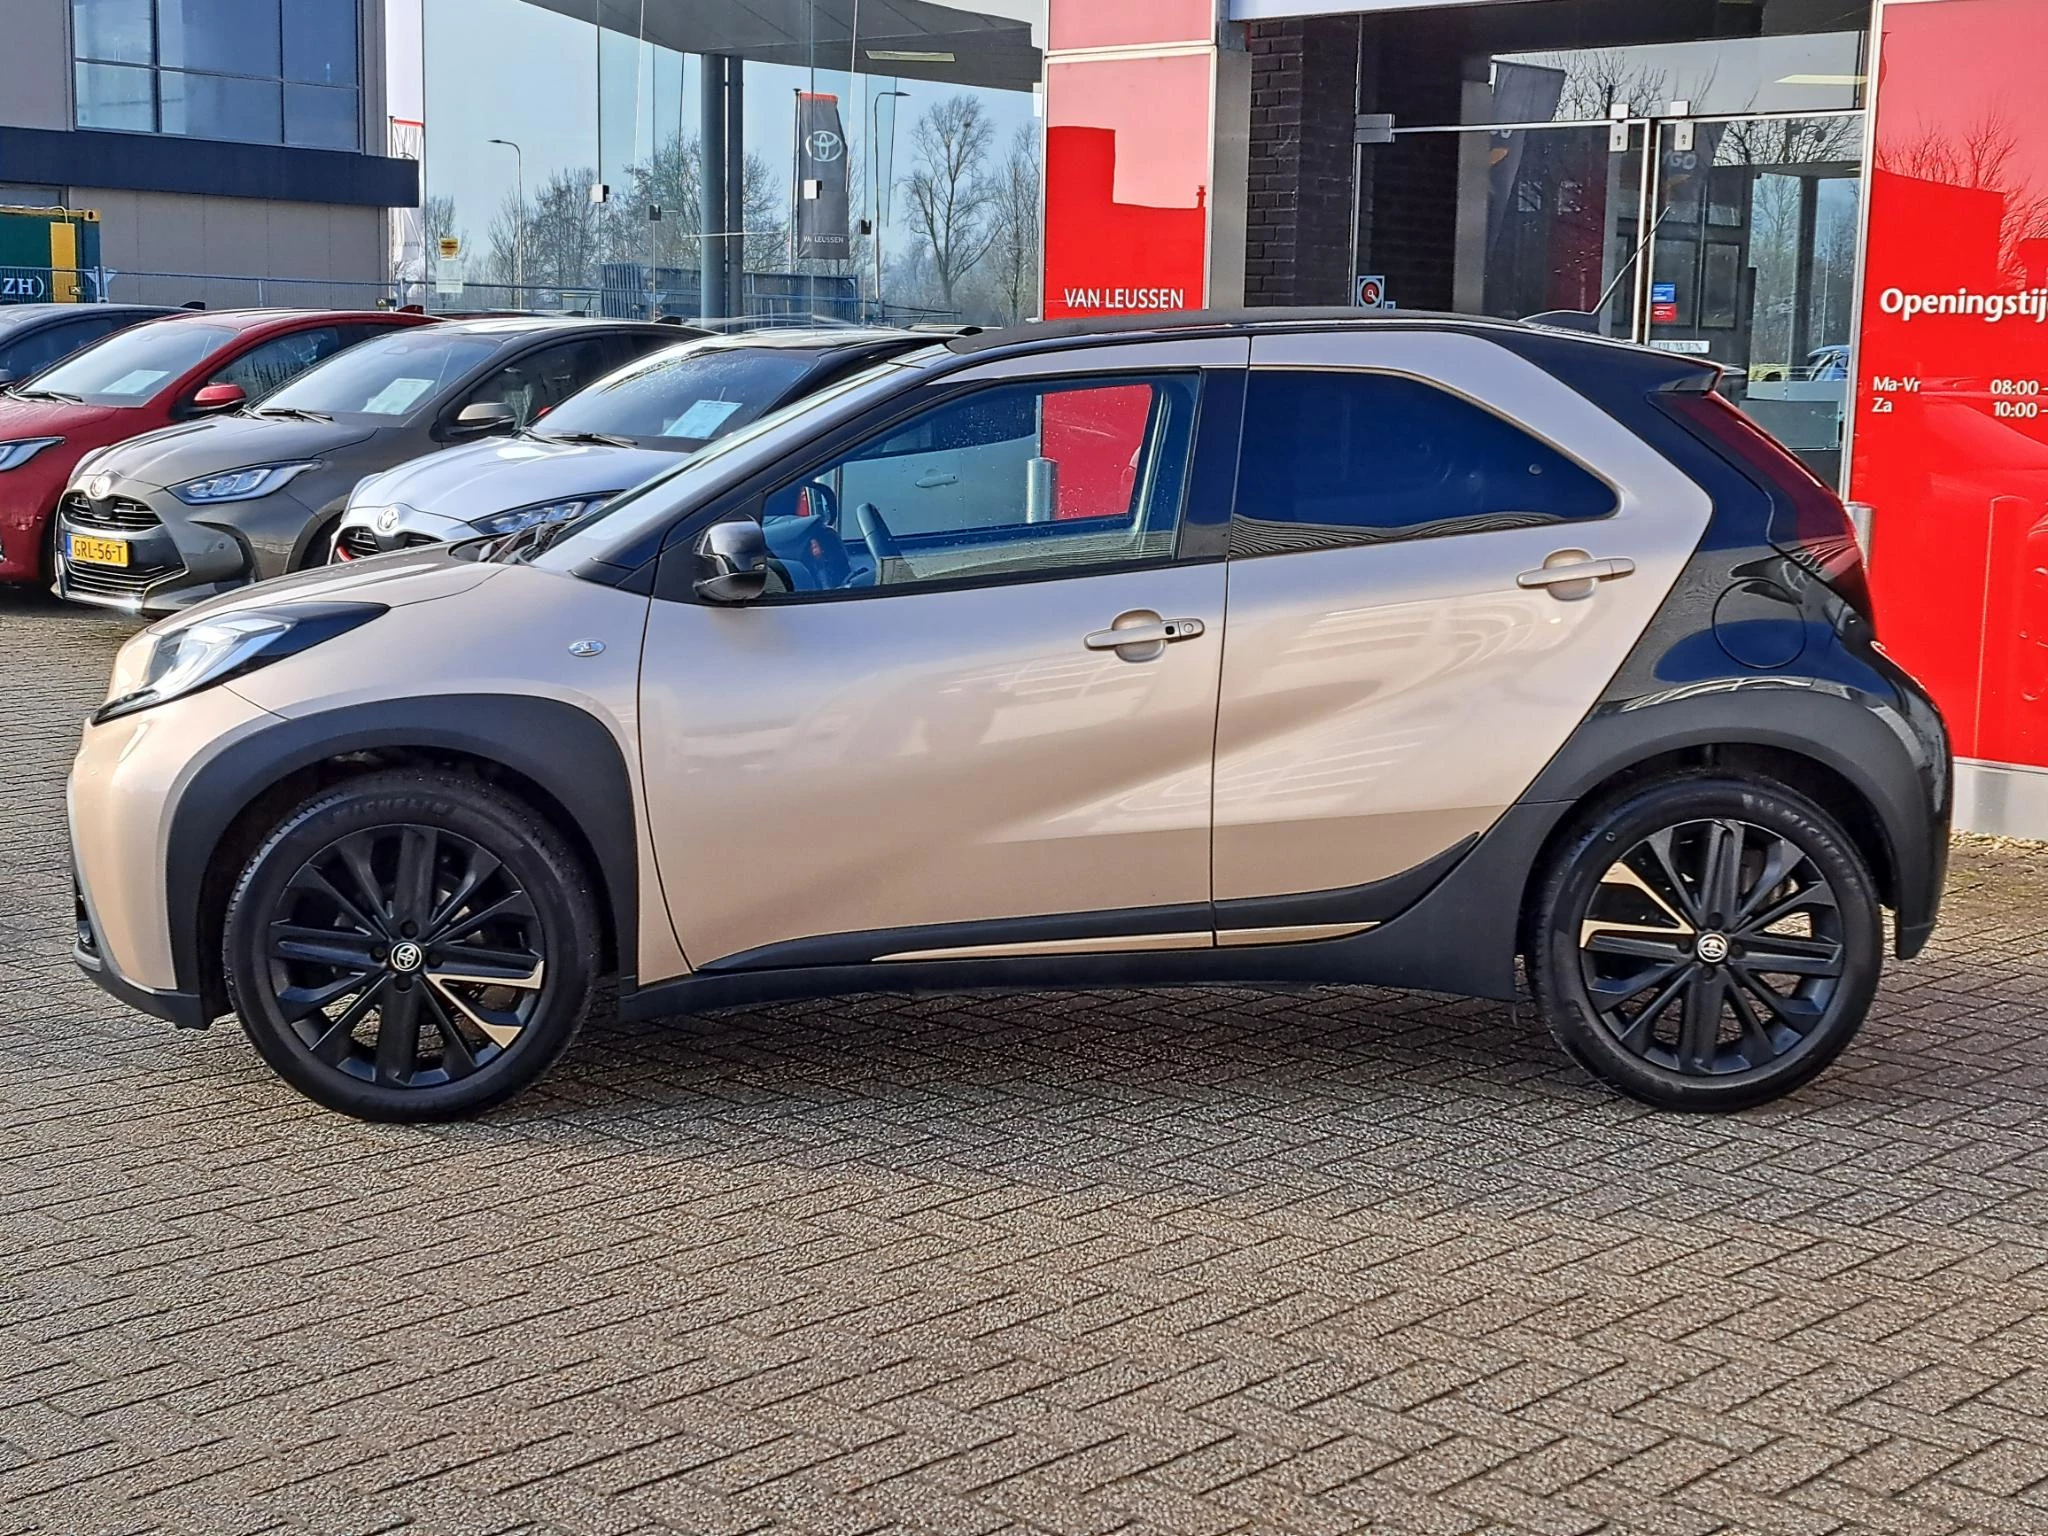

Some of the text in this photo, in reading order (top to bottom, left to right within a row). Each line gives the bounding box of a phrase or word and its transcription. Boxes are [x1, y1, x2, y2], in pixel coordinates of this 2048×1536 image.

[1064, 288, 1183, 309] VAN LEUSSEN
[1880, 288, 2048, 323] Openingstij
[1872, 376, 1921, 392] Ma-Vr
[1990, 379, 2039, 396] 08:00
[1871, 397, 1893, 413] Za
[1993, 401, 2038, 418] 10:00
[74, 540, 123, 562] GRL-56-T
